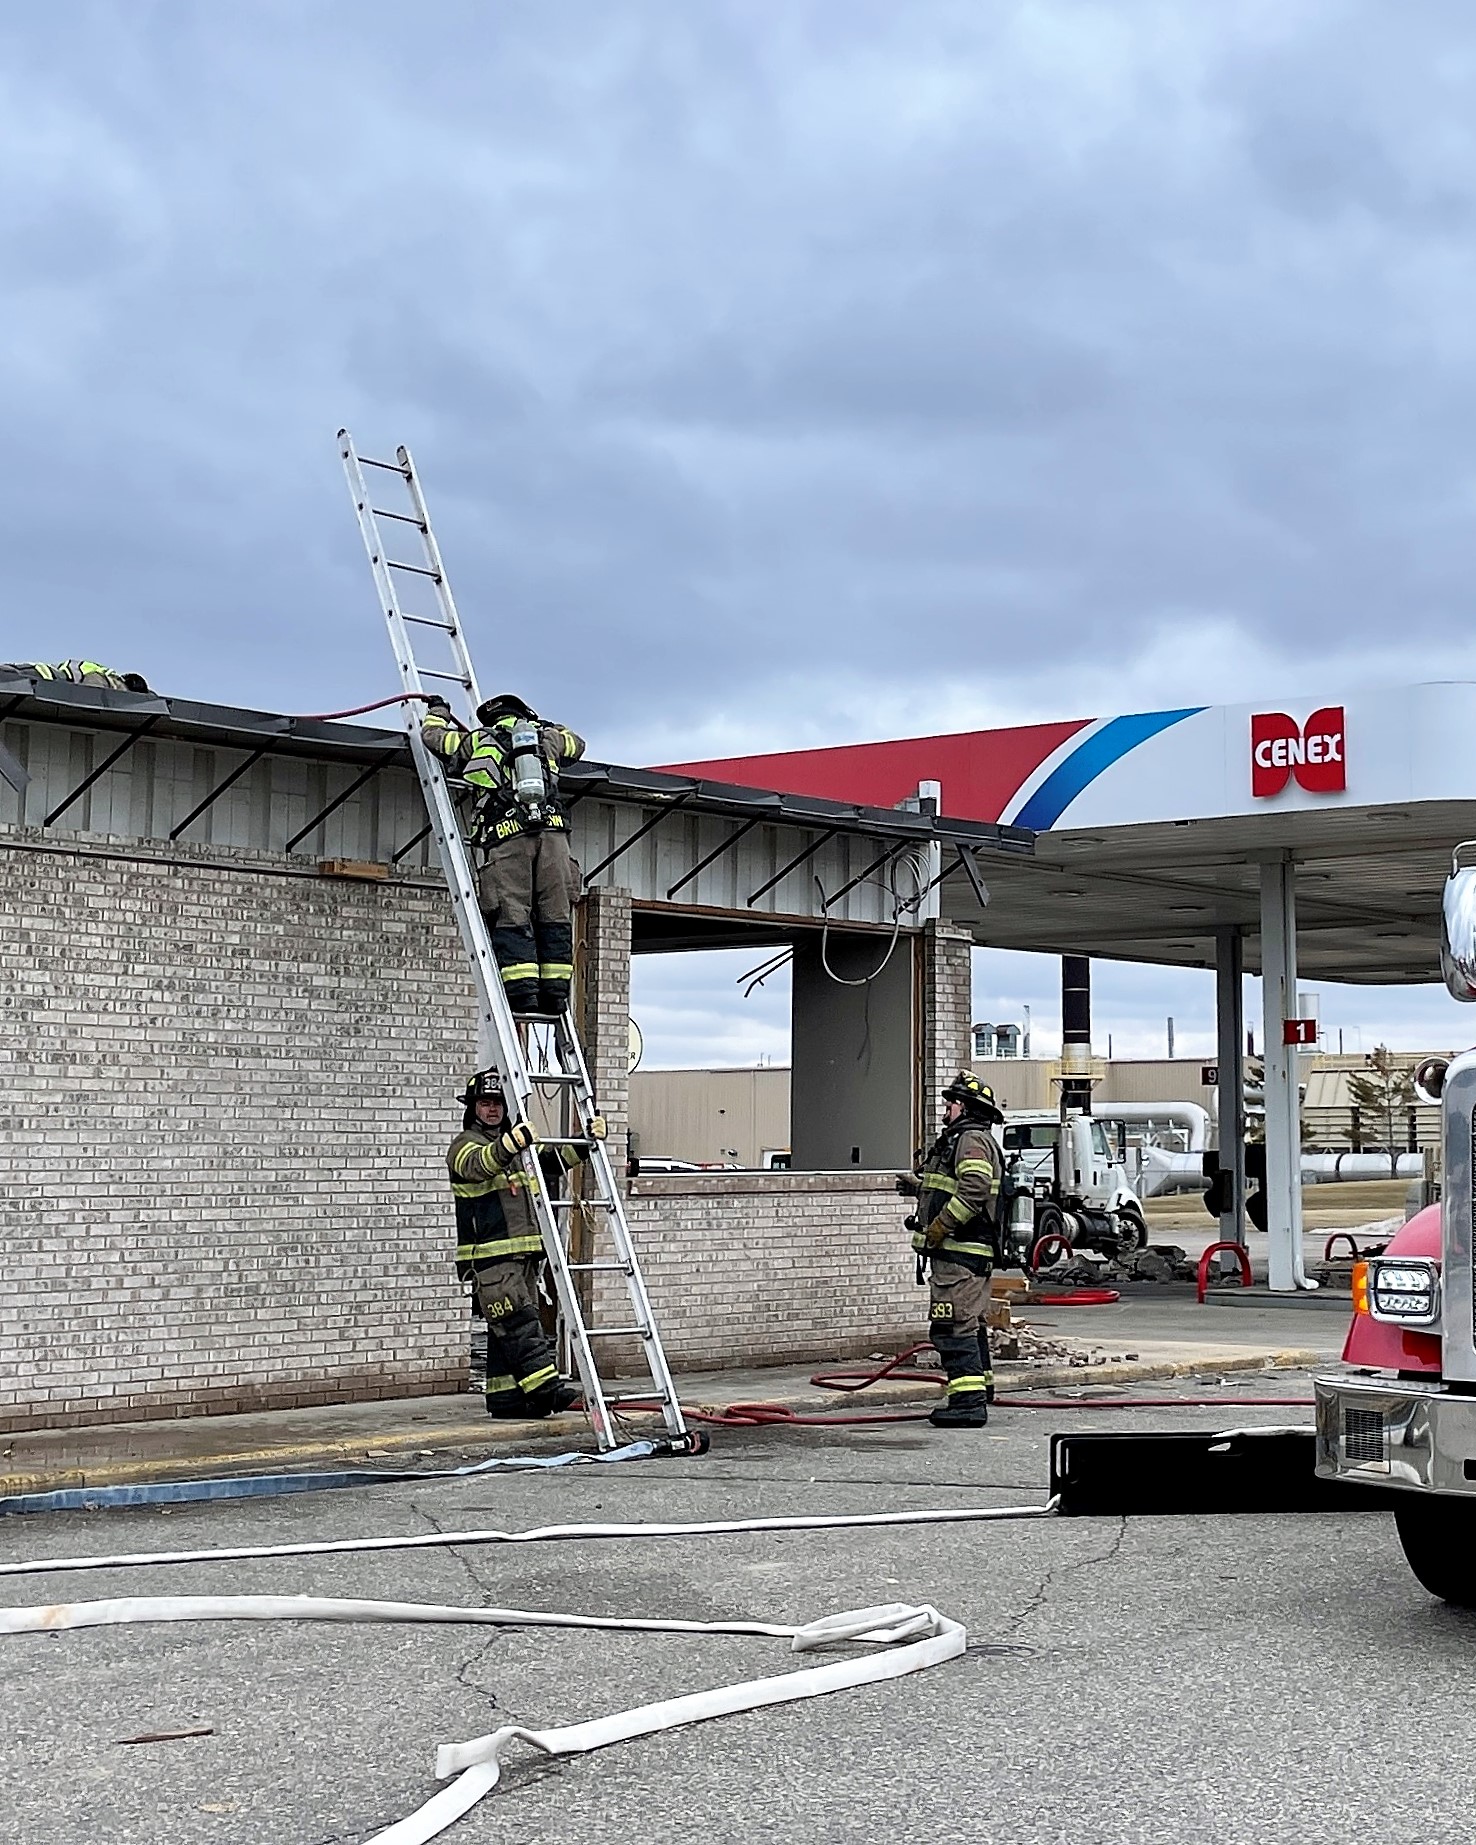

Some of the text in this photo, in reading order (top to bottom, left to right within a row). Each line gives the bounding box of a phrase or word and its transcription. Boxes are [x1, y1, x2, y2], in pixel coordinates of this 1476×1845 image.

[1255, 733, 1342, 768] CENEX
[1296, 1023, 1306, 1042] 1
[1208, 1069, 1217, 1083] 9
[487, 1297, 514, 1318] 384
[931, 1302, 953, 1318] 393
